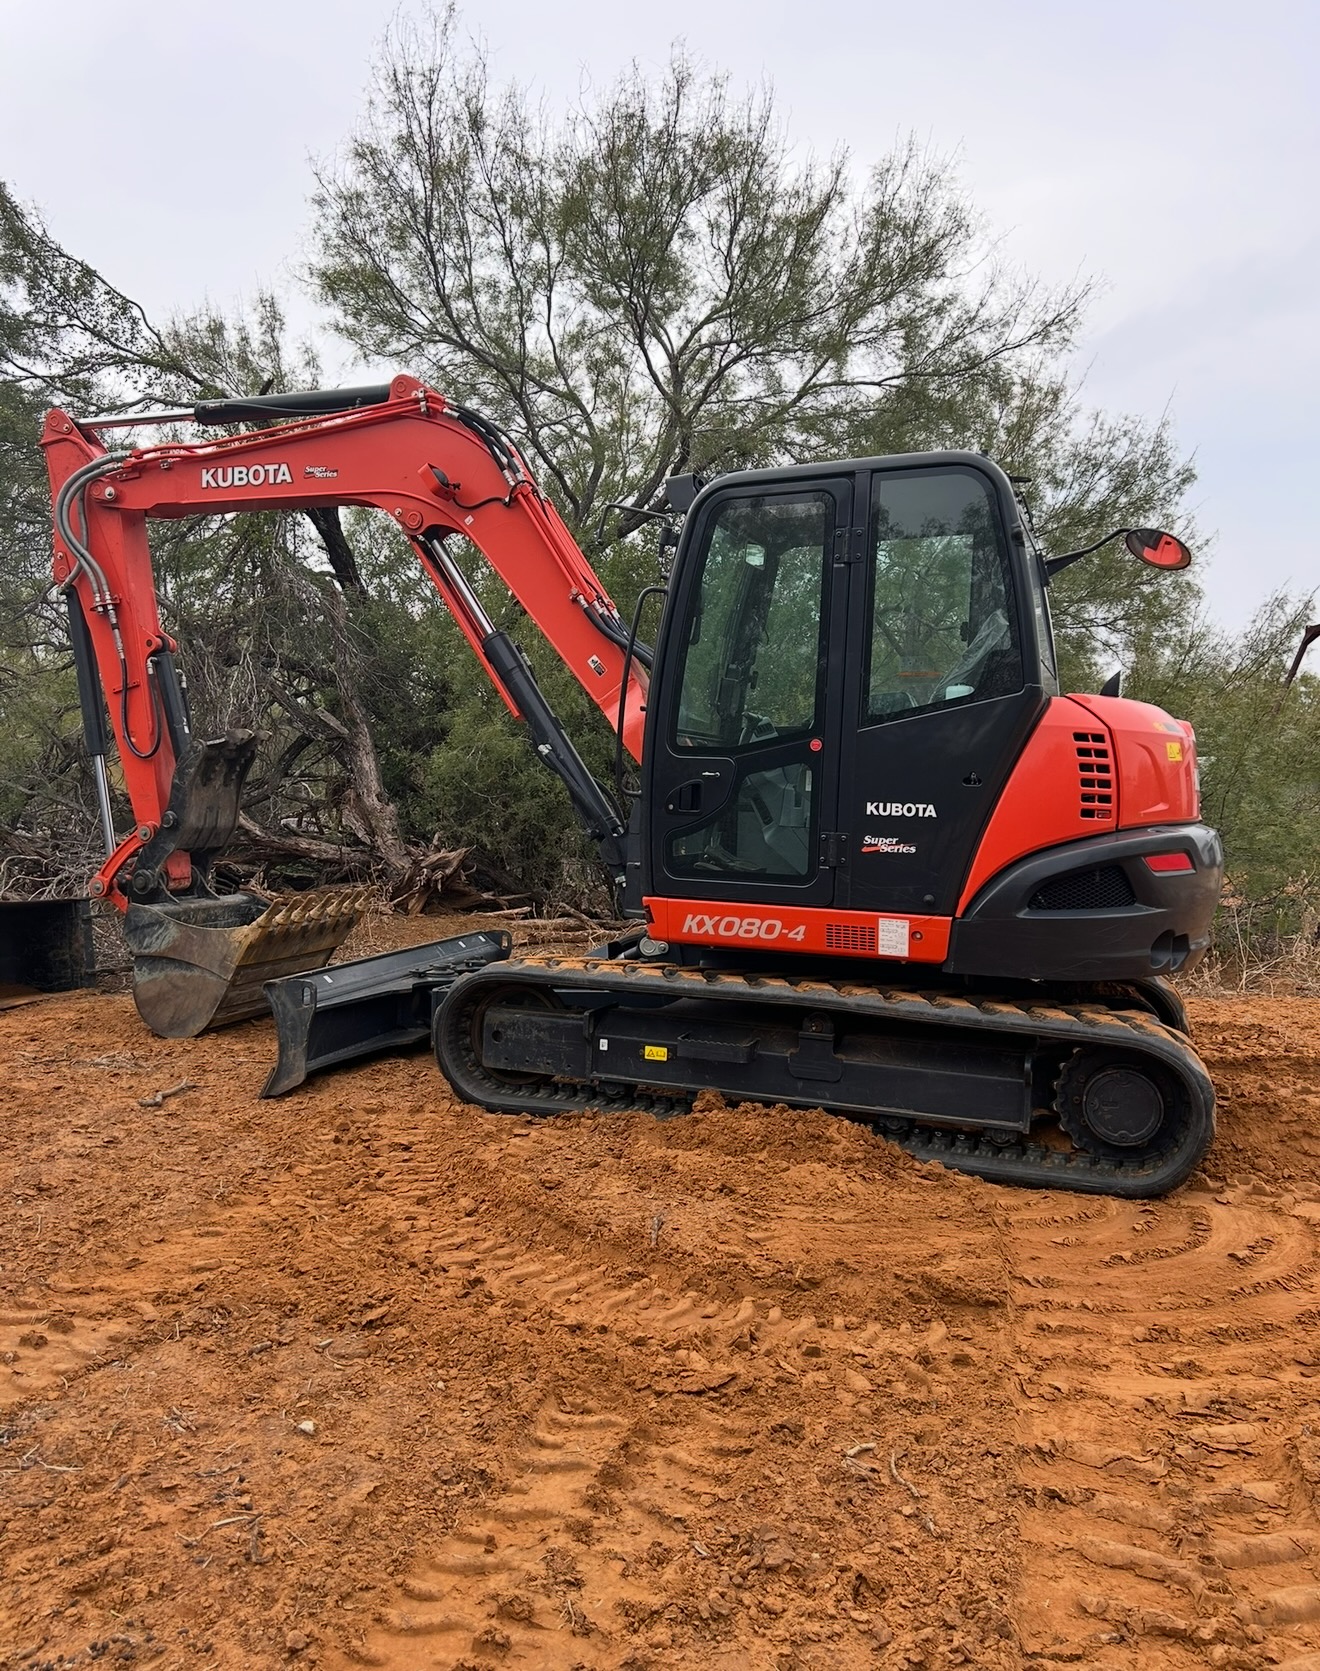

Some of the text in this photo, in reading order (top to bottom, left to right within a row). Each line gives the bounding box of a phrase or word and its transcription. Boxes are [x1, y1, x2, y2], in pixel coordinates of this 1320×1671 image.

[305, 465, 327, 474] Super
[315, 470, 338, 478] Series
[201, 463, 293, 488] KUBOTA
[866, 802, 937, 818] KUBOTA
[863, 835, 899, 846] Super
[880, 843, 917, 854] Series
[682, 914, 806, 942] KX080-4
